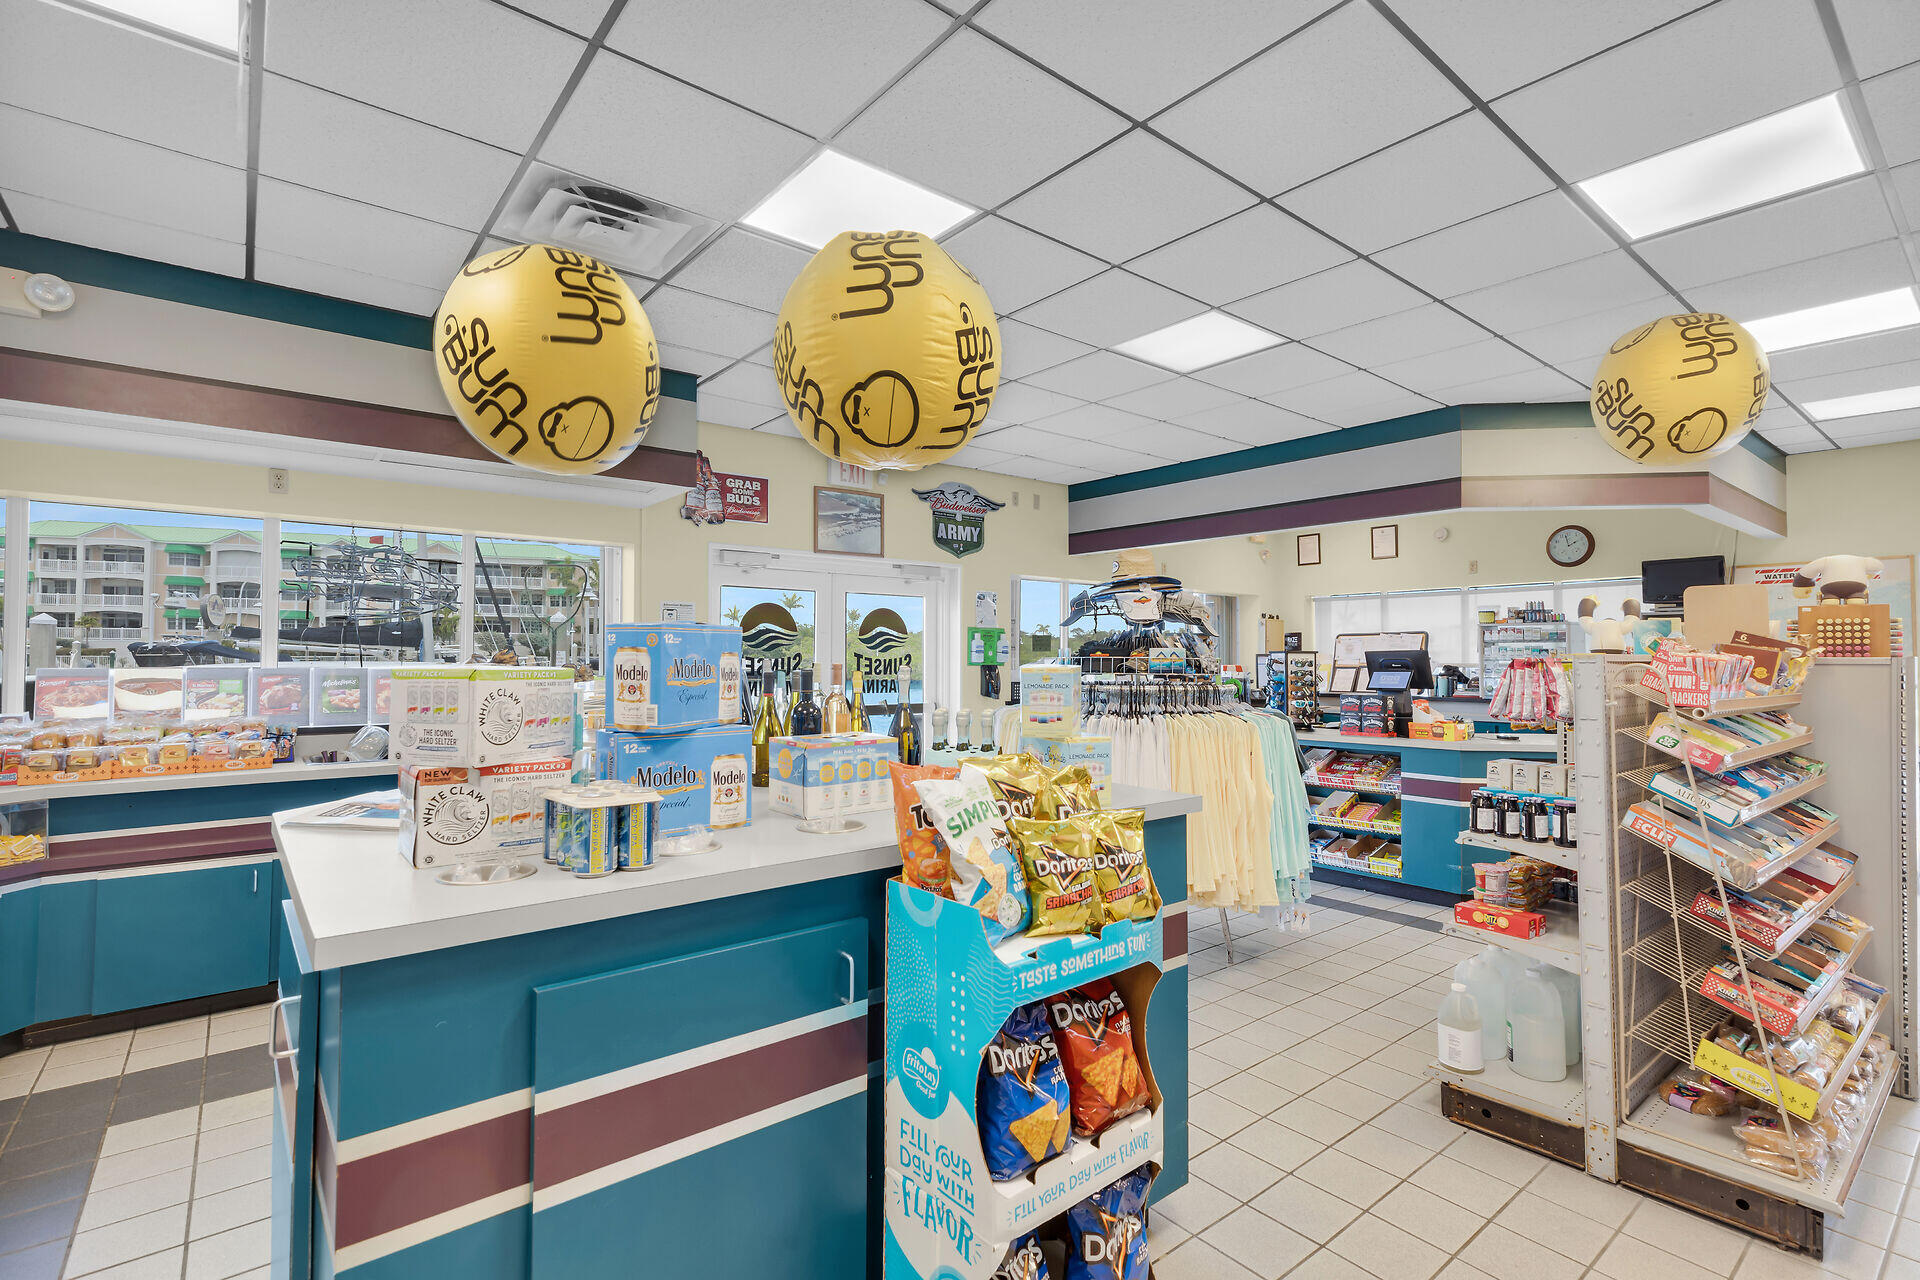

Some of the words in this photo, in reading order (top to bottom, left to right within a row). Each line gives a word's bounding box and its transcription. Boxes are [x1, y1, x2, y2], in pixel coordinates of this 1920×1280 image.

[725, 478, 761, 491] GRAB
[732, 488, 755, 496] SOME
[726, 493, 760, 506] BUDS
[928, 496, 988, 515] Budweiser
[937, 522, 981, 543] ARMY
[664, 634, 673, 644] 12
[504, 671, 531, 679] VARIETY
[616, 664, 648, 681] Modelo
[673, 658, 712, 679] Modelo
[1668, 675, 1696, 689] YUM!
[479, 692, 496, 726] WHITE
[497, 688, 521, 705] CLAW
[1672, 692, 1709, 706] RACKERS
[419, 736, 433, 745] HARD
[435, 738, 457, 746] SELTZER
[424, 729, 433, 737] THE
[434, 729, 454, 738] ICONIC
[623, 743, 638, 754] 12
[424, 770, 451, 779] NEW
[493, 766, 530, 774] VARIETY
[637, 765, 696, 788] Modelo
[713, 769, 746, 786] Modelo
[422, 790, 447, 827] WHITE
[450, 787, 486, 803] CLAW
[434, 831, 458, 843] HARD
[462, 810, 487, 841] SELTZER
[1035, 857, 1094, 877] Doritos
[1094, 850, 1144, 871] Doritos
[1046, 885, 1093, 910] SRIRACHA
[1127, 933, 1147, 956] FUN
[1717, 987, 1737, 999] KIND
[1052, 991, 1125, 1029] Doritos
[989, 1035, 1058, 1074] Doritos
[1119, 1131, 1149, 1164] FLAVOR
[900, 1174, 976, 1265] FLAVOR
